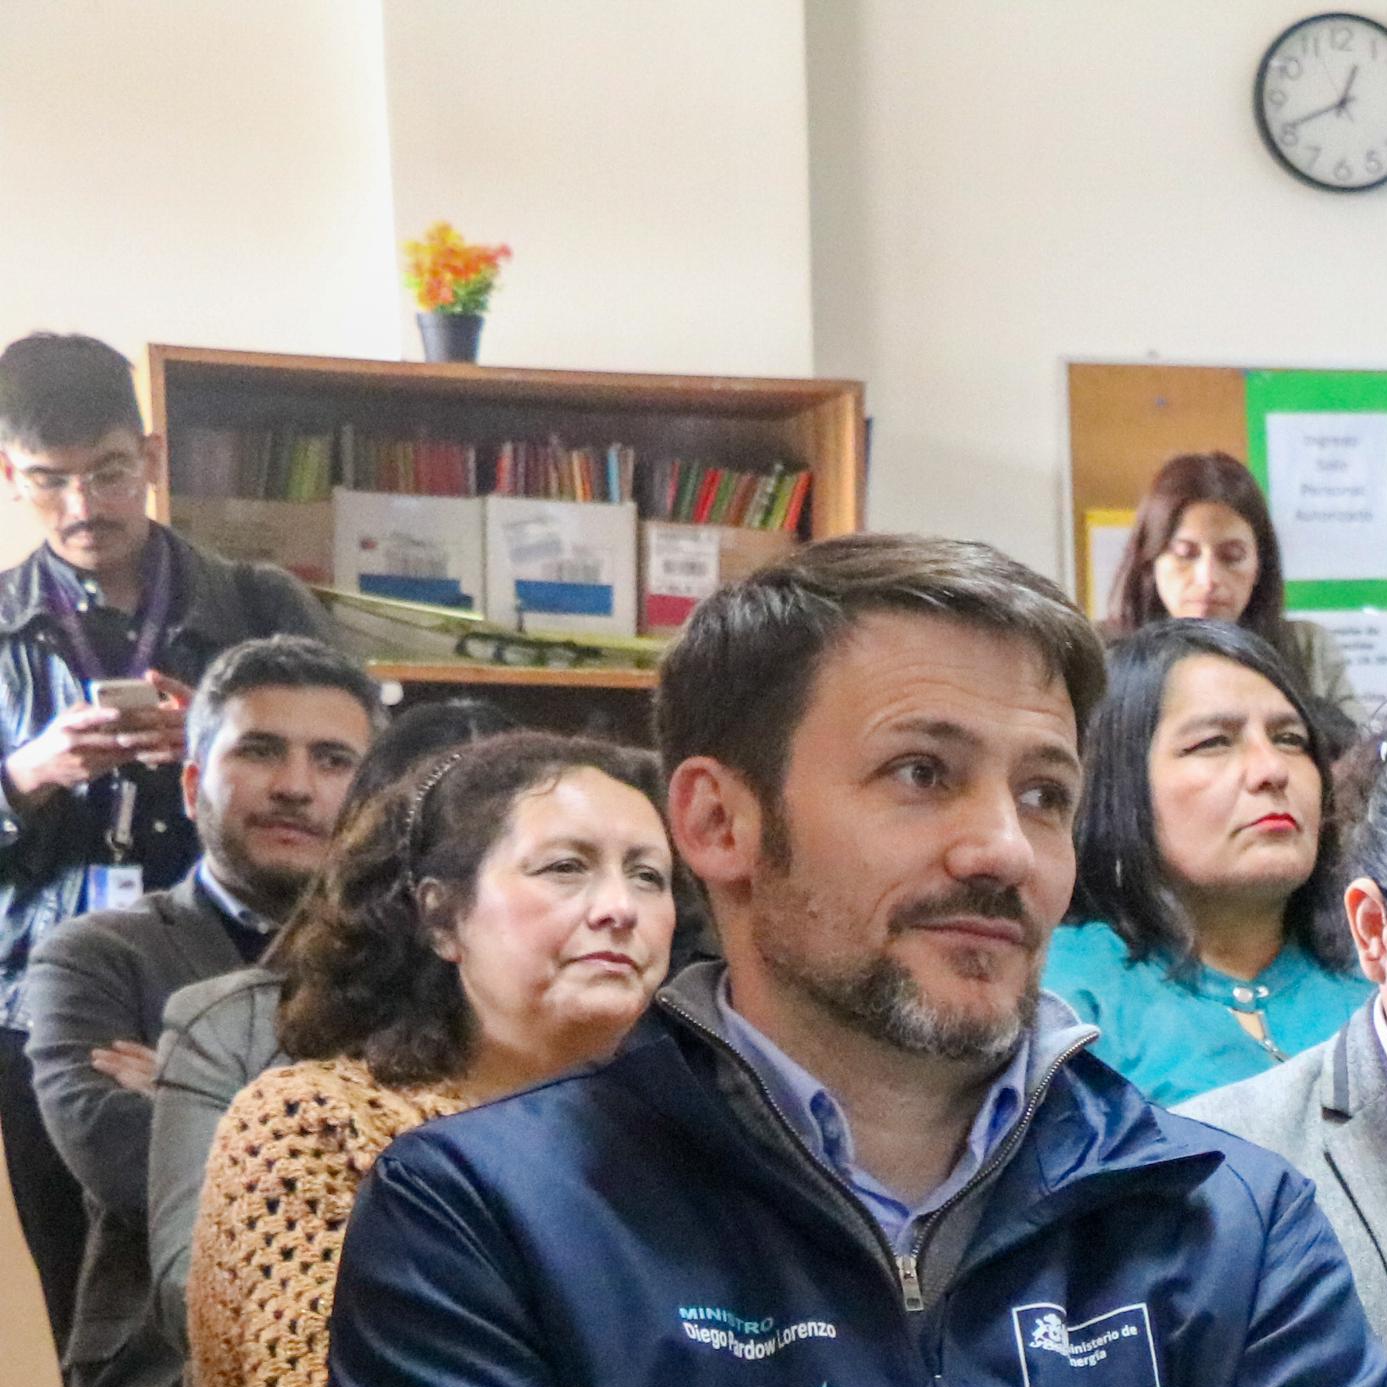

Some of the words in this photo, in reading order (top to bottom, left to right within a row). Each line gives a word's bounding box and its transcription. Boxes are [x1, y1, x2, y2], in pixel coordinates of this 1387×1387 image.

[1301, 36, 1321, 58] 11
[1329, 26, 1355, 53] 12
[1269, 88, 1288, 111] 9
[1279, 122, 1299, 147] 8
[1333, 157, 1352, 182] 6
[1365, 149, 1384, 174] 5
[679, 1307, 774, 1335] MINISTRO
[682, 1322, 728, 1350] Diego
[728, 1330, 777, 1361] Pardow
[776, 1321, 837, 1349] Lorenzo
[1069, 1330, 1119, 1355] inisterio
[1121, 1324, 1138, 1337] de
[1069, 1349, 1107, 1367] nergía
